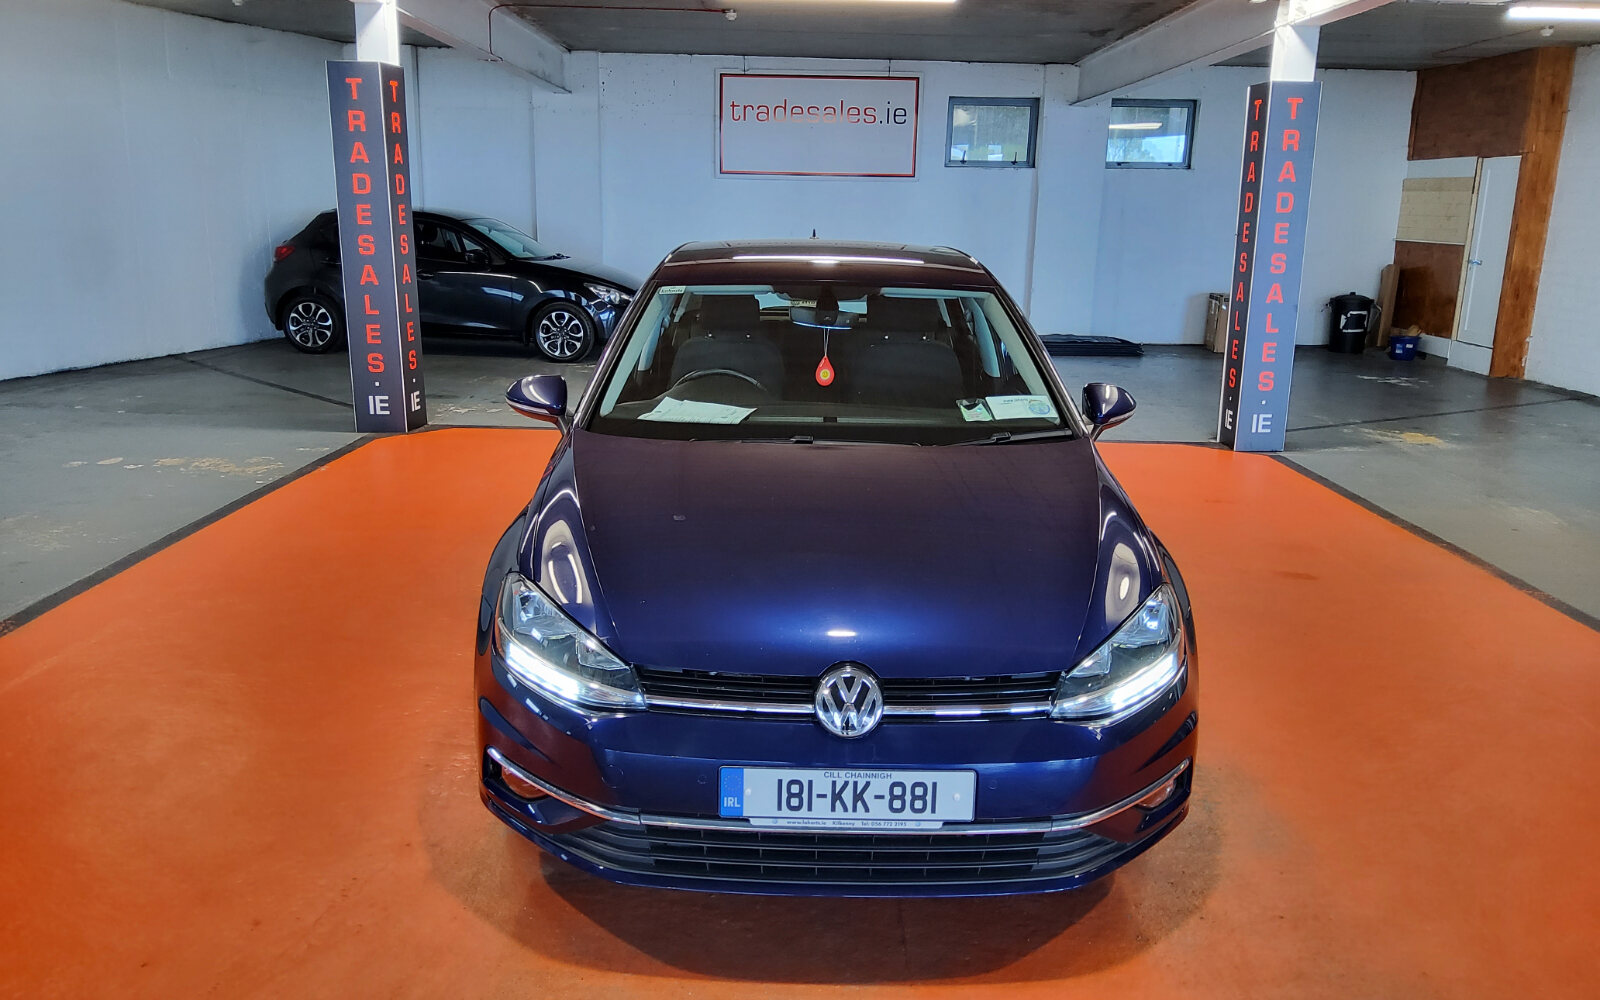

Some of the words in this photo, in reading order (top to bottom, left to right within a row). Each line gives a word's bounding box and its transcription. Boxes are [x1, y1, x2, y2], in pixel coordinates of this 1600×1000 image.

[730, 98, 907, 125] tradesales.ie
[823, 771, 846, 779] CILL
[847, 772, 892, 780] CHAINNIGH
[723, 796, 741, 808] IRL
[776, 778, 938, 815] 181-KK-881
